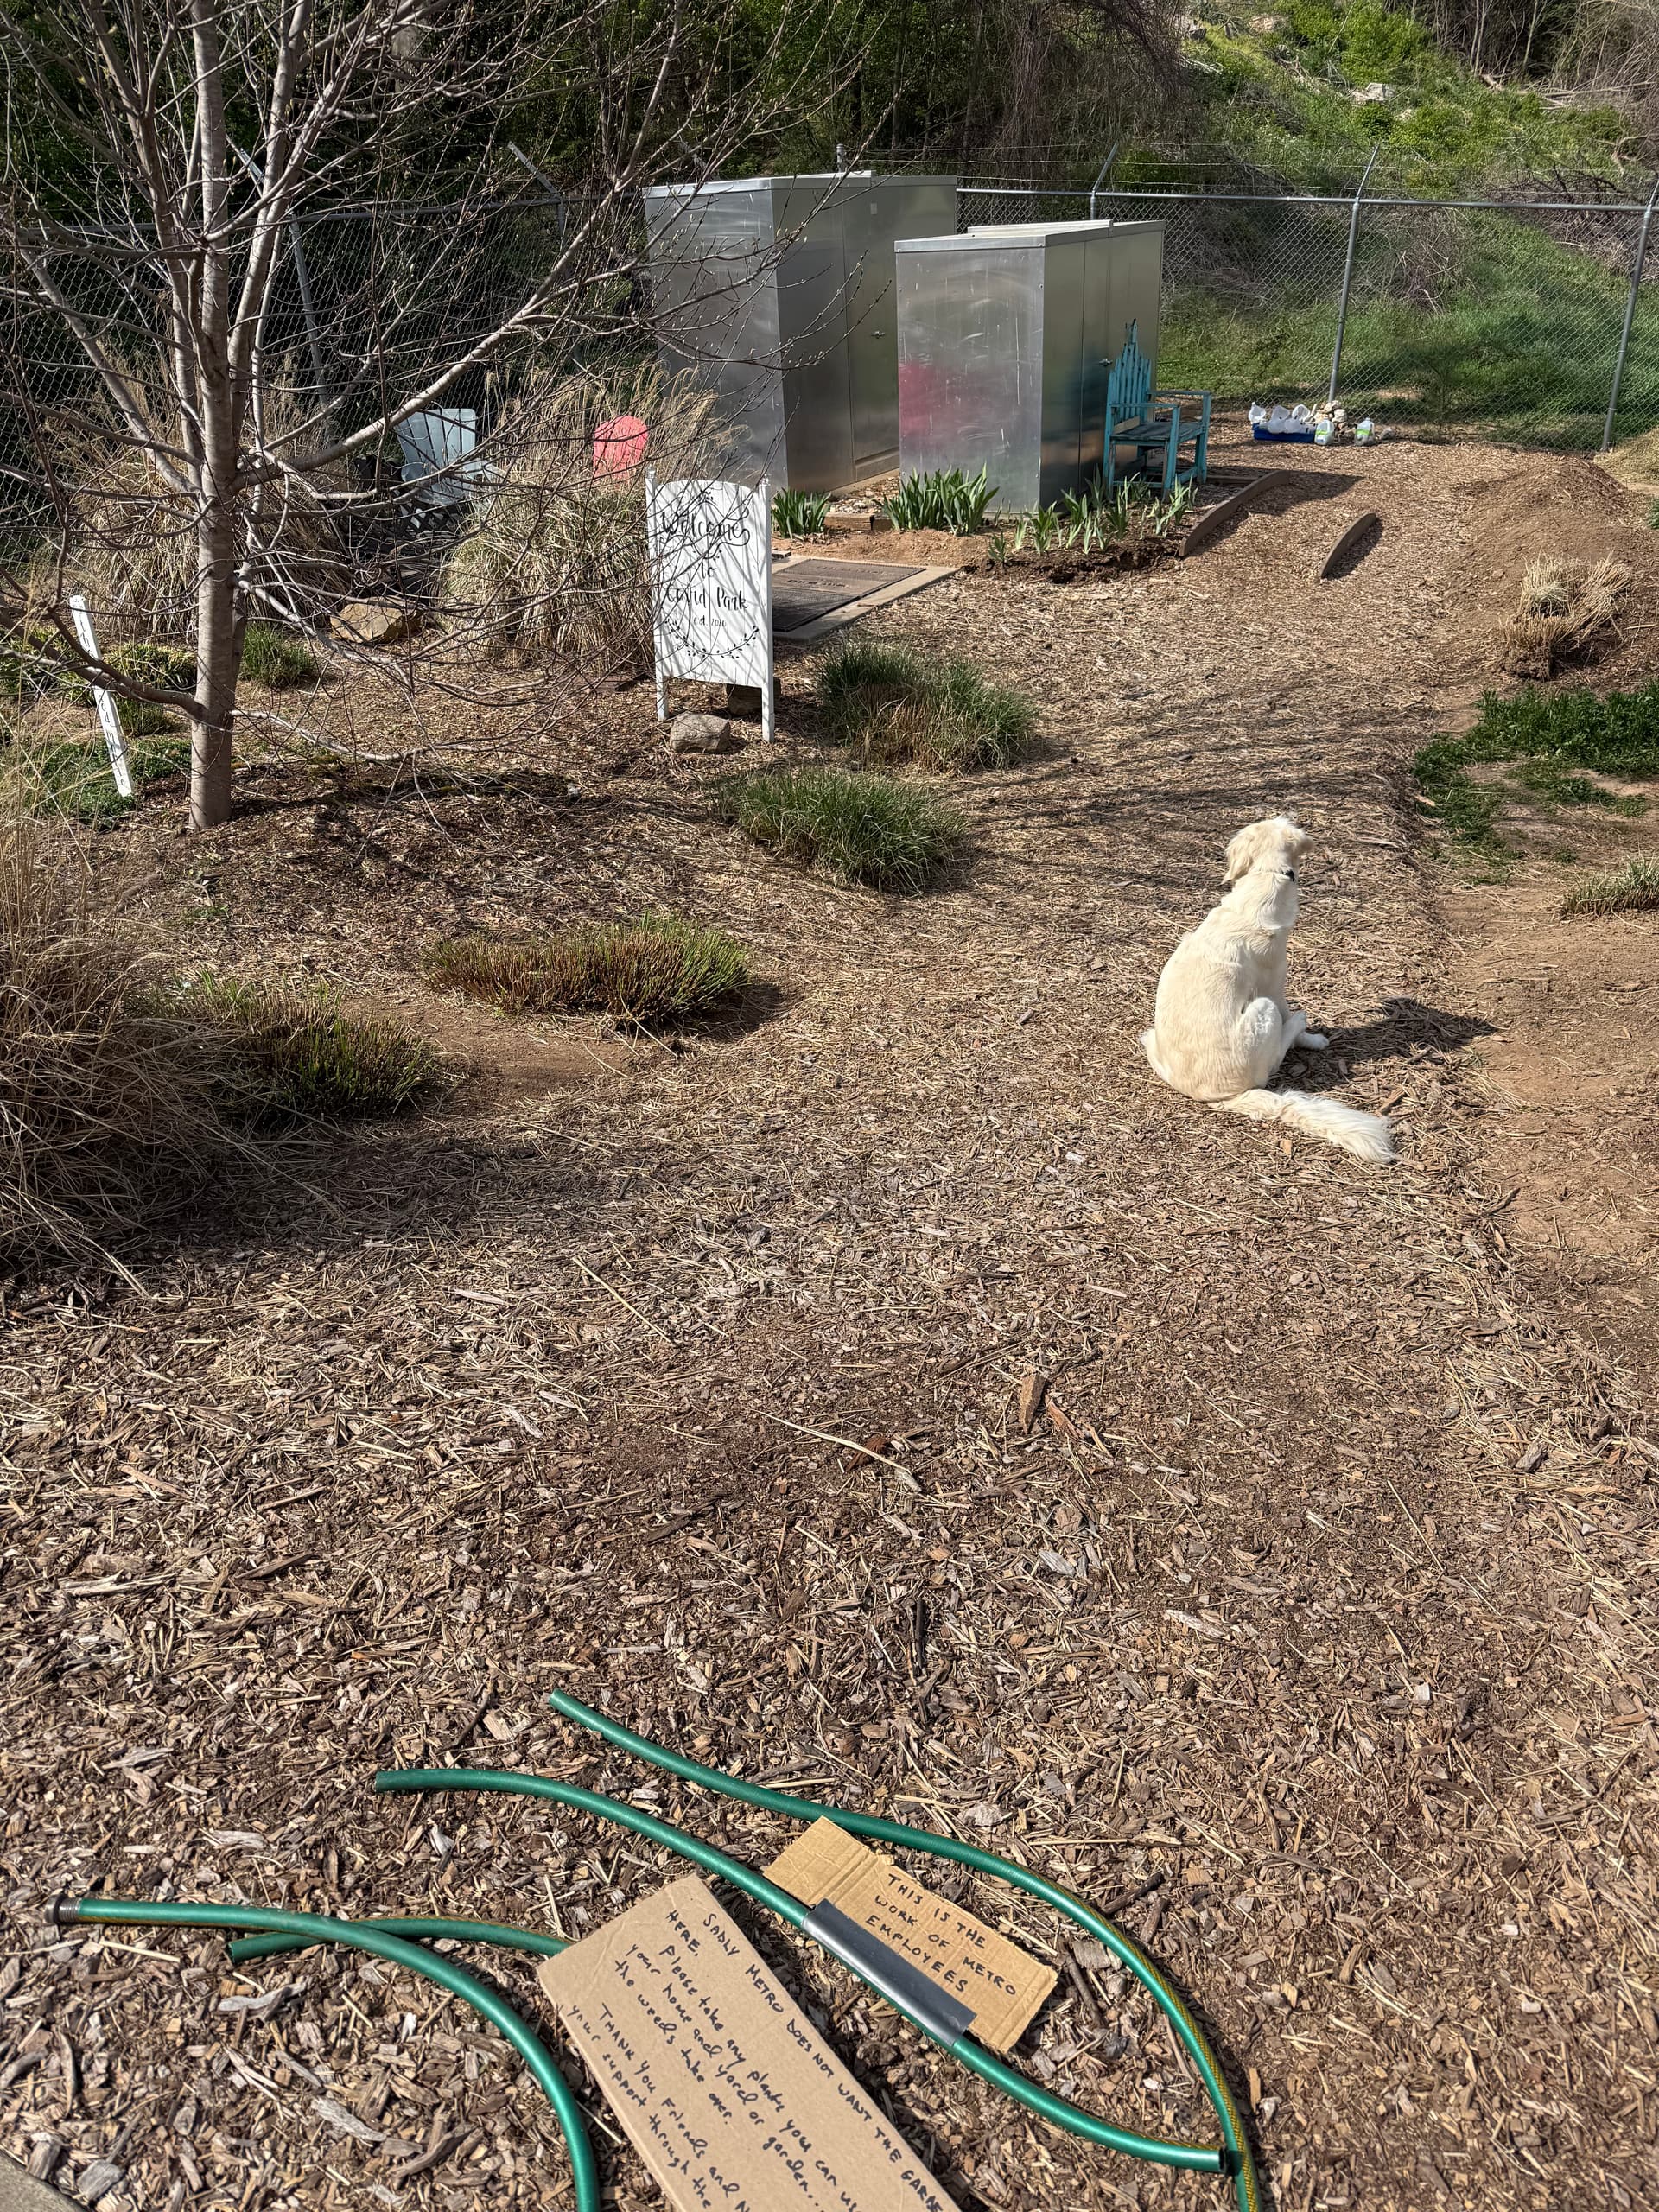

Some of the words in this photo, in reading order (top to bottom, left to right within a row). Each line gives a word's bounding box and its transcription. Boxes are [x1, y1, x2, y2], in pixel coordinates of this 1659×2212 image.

[662, 510, 745, 541] Welcome
[717, 587, 748, 610] Park
[665, 1910, 701, 1957] HERE.
[865, 1914, 969, 1993] EMPLOYEES
[874, 1895, 918, 1927] WORK
[928, 1934, 950, 1948] OF
[963, 1956, 1016, 1995] METRO
[888, 1873, 924, 1905] THIS
[933, 1907, 950, 1923] IS
[957, 1922, 986, 1949] THE
[614, 1960, 635, 1987] the
[637, 1994, 677, 2045] weeds
[681, 2048, 704, 2083] take
[626, 1944, 661, 1974] your
[663, 1982, 692, 2023] home
[693, 2028, 722, 2058] and
[715, 2064, 759, 2105] yard
[749, 2111, 765, 2126] or
[658, 1945, 697, 1995] Please
[698, 1997, 724, 2031] take
[727, 2039, 746, 2069] any
[779, 2119, 812, 2153] you
[815, 2160, 837, 2187] can
[703, 1913, 740, 1956] SADLY
[745, 1963, 784, 2013] METRO
[786, 2018, 813, 2053] DOES
[813, 2053, 835, 2078] NOT
[838, 2083, 873, 2122] WANT
[874, 2126, 903, 2164] THE
[566, 2005, 601, 2041] your
[602, 2053, 648, 2107] support
[649, 2113, 690, 2175] through
[692, 2177, 711, 2209] the
[600, 2002, 635, 2061] THANK
[661, 2097, 708, 2159] Friends
[709, 2166, 740, 2198] and
